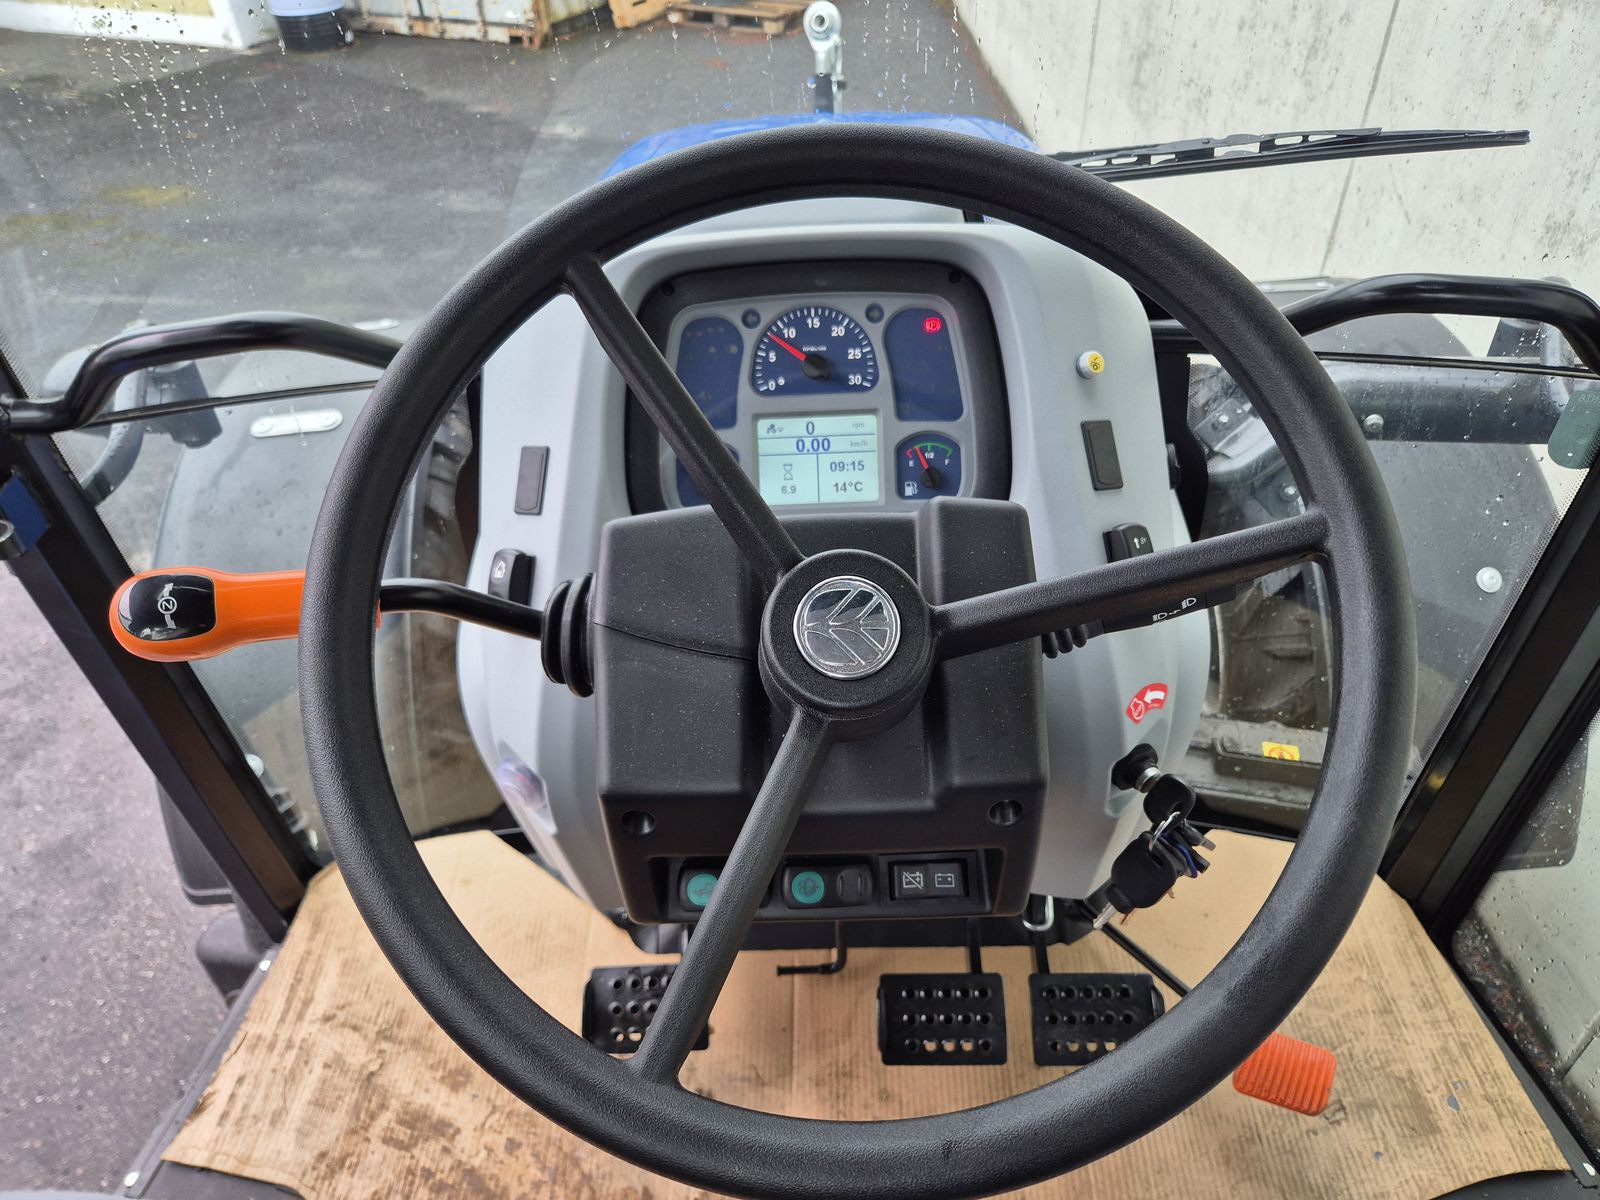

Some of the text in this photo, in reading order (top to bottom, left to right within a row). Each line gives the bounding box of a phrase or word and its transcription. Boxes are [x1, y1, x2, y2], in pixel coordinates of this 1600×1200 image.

[806, 318, 820, 329] 15
[783, 328, 796, 339] 10
[831, 326, 845, 337] 20
[768, 351, 776, 362] 5
[848, 348, 861, 360] 25
[768, 380, 776, 391] 0
[848, 375, 862, 385] 30
[806, 421, 815, 435] 0
[852, 422, 865, 430] rpm
[796, 437, 831, 453] 0.00
[850, 440, 868, 448] km/h
[829, 460, 865, 472] 09:15
[781, 485, 797, 495] 6.9
[833, 481, 863, 493] 14°C
